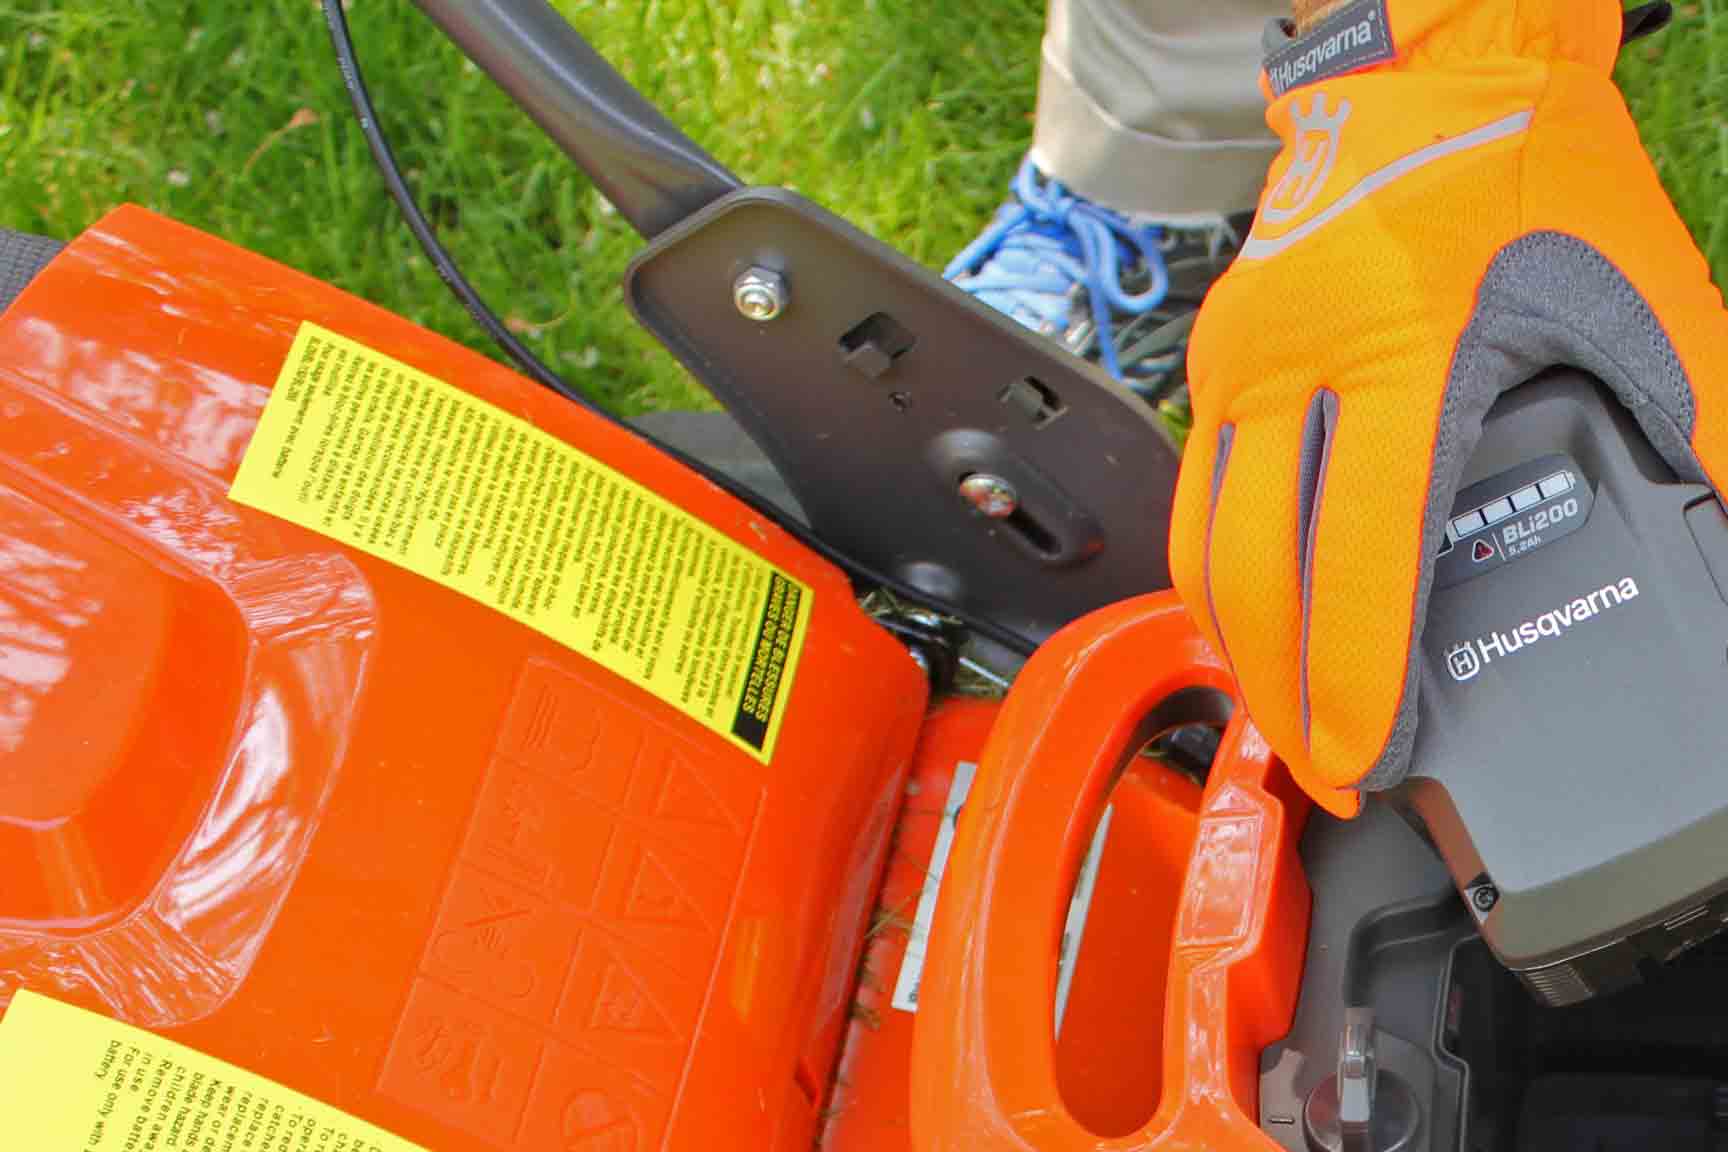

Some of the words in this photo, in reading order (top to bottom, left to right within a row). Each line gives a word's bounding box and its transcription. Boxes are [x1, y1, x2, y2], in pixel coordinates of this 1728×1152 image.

[1279, 20, 1372, 91] Husqvarna
[1503, 498, 1578, 545] BLi200
[1477, 577, 1639, 664] Husqvarna
[119, 1044, 139, 1068] For
[139, 1050, 154, 1066] in
[109, 1067, 127, 1090] use
[138, 1057, 171, 1114] Remove
[154, 1064, 187, 1122] children
[181, 1070, 204, 1105] blade
[195, 1075, 221, 1110] Keep
[95, 1089, 120, 1119] only
[214, 1083, 235, 1117] wear
[86, 1118, 108, 1147] with
[182, 1108, 208, 1148] hands
[207, 1117, 221, 1134] or
[237, 1094, 270, 1149] replace
[285, 1110, 302, 1130] To
[317, 1123, 335, 1144] To
